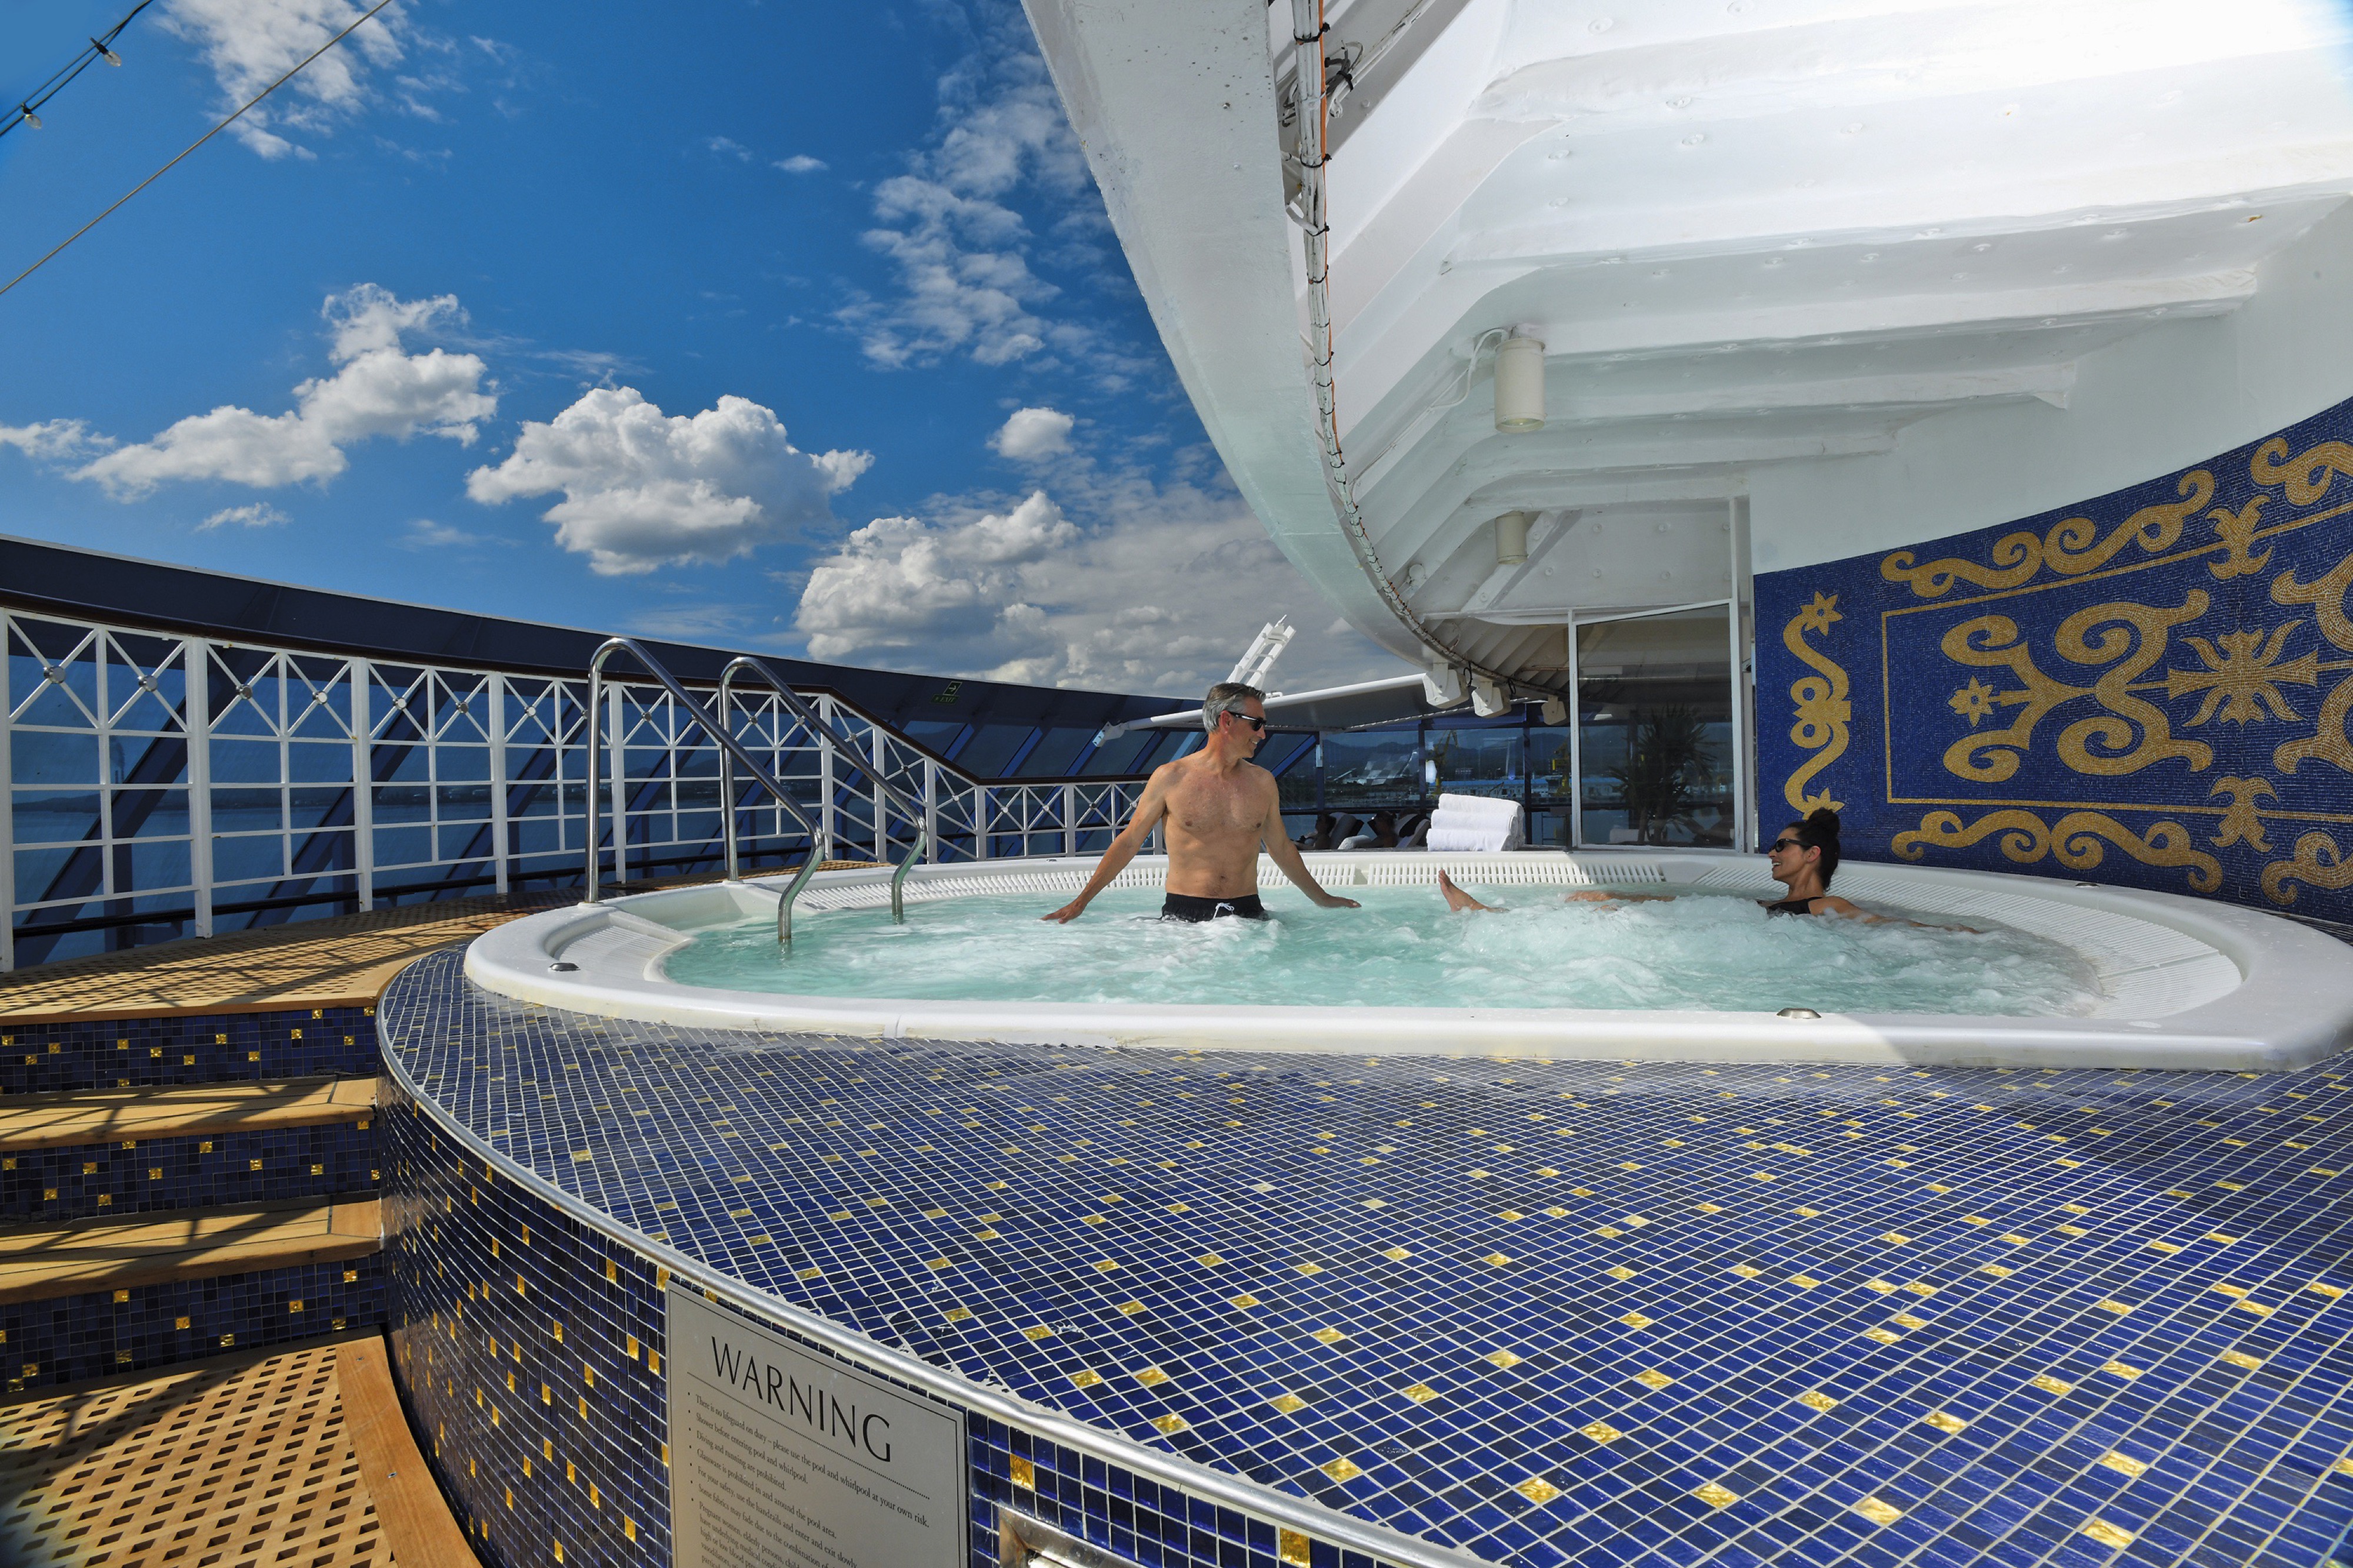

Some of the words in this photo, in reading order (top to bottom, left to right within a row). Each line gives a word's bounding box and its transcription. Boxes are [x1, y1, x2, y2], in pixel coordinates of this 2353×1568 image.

[711, 1336, 891, 1463] WARNING
[695, 1394, 709, 1409] There
[710, 1403, 715, 1412] is
[722, 1410, 745, 1430] lifeguard
[746, 1426, 754, 1434] on
[754, 1429, 767, 1443] duty
[773, 1440, 789, 1454] please
[791, 1450, 800, 1460] use
[801, 1454, 811, 1466] the
[812, 1462, 825, 1474] pool
[827, 1470, 838, 1481] and
[840, 1476, 871, 1497] whirlpool
[872, 1493, 879, 1502] at
[880, 1497, 896, 1510] your
[897, 1506, 912, 1519] own
[914, 1513, 929, 1527] risk.
[696, 1412, 714, 1429] Shower
[714, 1423, 730, 1439] before
[731, 1436, 753, 1455] entering
[753, 1449, 765, 1460] pool
[766, 1457, 778, 1467] and
[778, 1462, 808, 1484] whirlpool.
[696, 1430, 714, 1450] Diving
[714, 1444, 724, 1454] and
[725, 1450, 746, 1469] running
[747, 1463, 755, 1472] are
[756, 1469, 786, 1491] prohibited.
[696, 1449, 721, 1470] Glassware
[722, 1463, 727, 1473] is
[727, 1470, 754, 1490] prohibited
[755, 1484, 761, 1494] in
[762, 1491, 773, 1502] and
[774, 1498, 795, 1514] around
[796, 1509, 806, 1521] the
[807, 1517, 821, 1530] pool
[822, 1526, 836, 1539] area.
[698, 1483, 712, 1499] Some
[713, 1493, 729, 1510] fabrics
[730, 1507, 742, 1520] may
[742, 1512, 754, 1526] fade
[755, 1520, 765, 1533] due
[766, 1529, 772, 1537] to
[773, 1532, 782, 1544] the
[783, 1541, 820, 1568] combination
[707, 1474, 718, 1485] your
[719, 1482, 735, 1497] safety,
[736, 1493, 745, 1502] use
[746, 1497, 755, 1509] the
[755, 1502, 782, 1525] handrails
[782, 1522, 794, 1533] and
[795, 1529, 809, 1542] enter
[811, 1539, 822, 1550] and
[824, 1546, 835, 1557] exit
[743, 1532, 760, 1550] elderly
